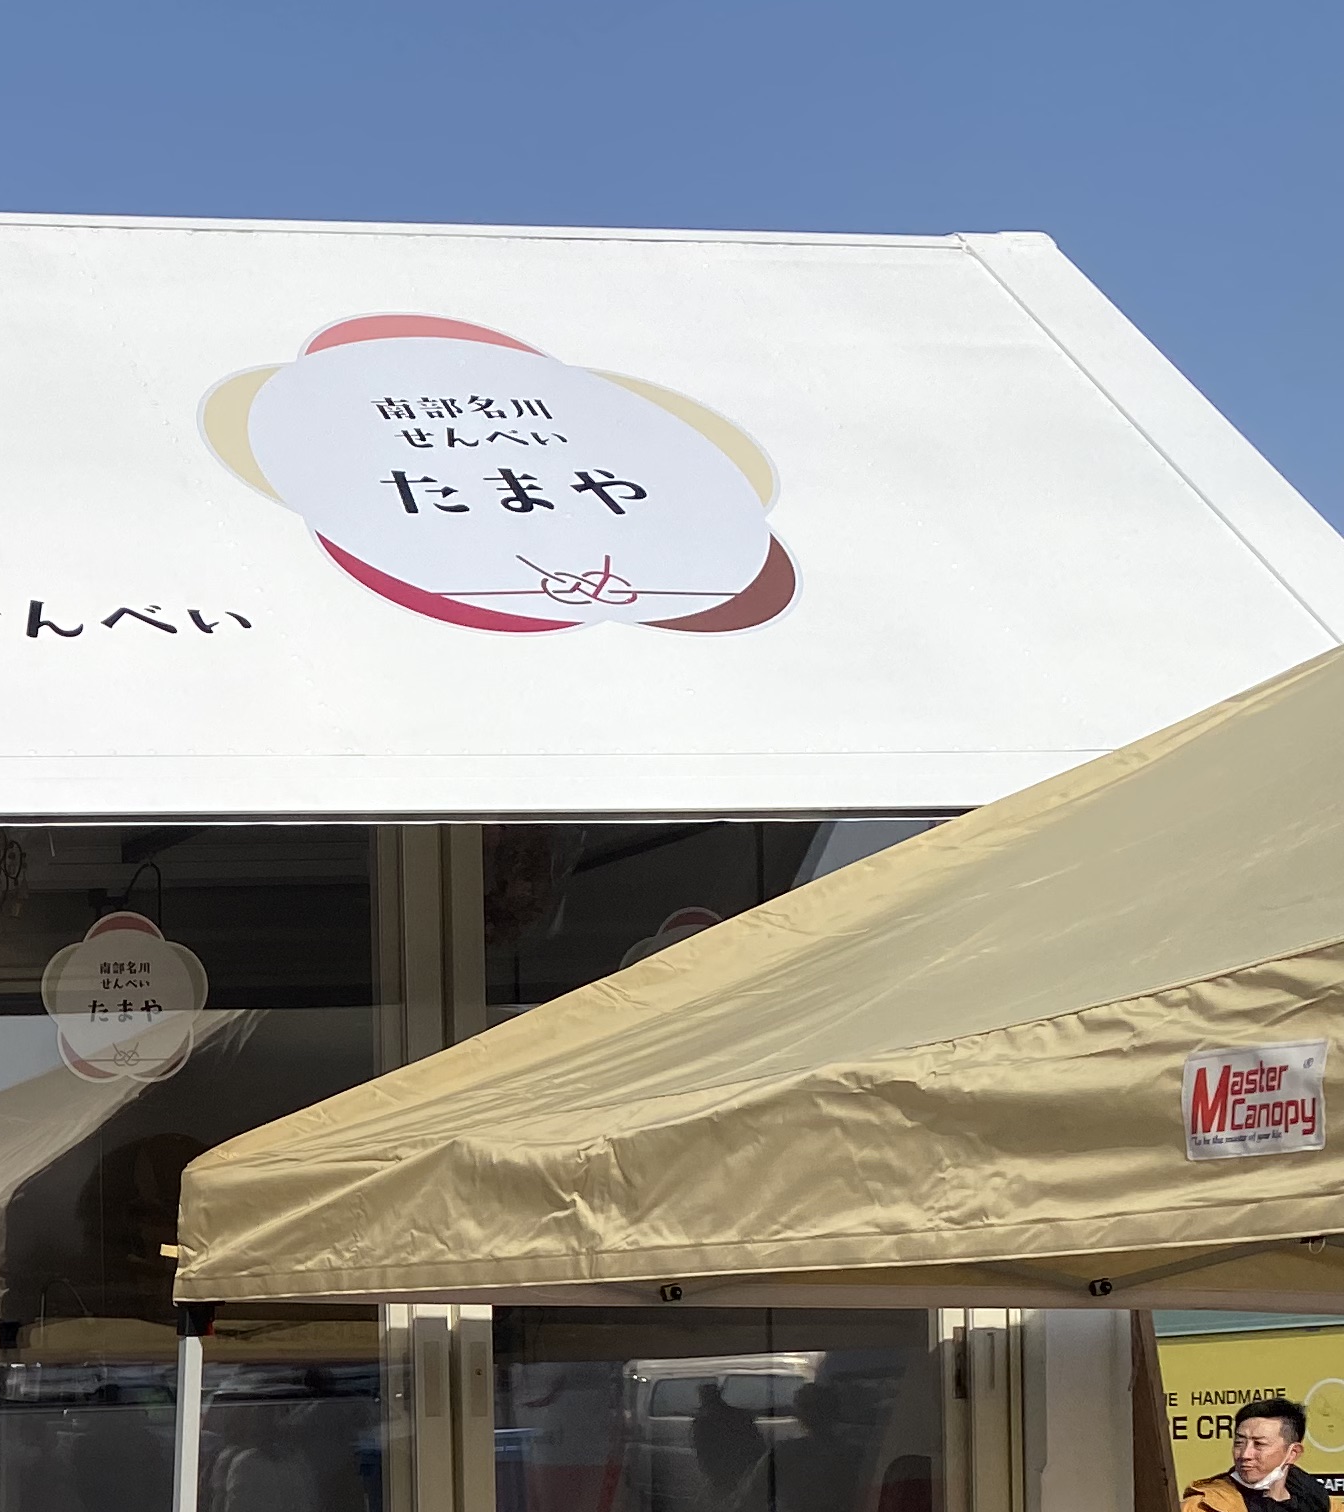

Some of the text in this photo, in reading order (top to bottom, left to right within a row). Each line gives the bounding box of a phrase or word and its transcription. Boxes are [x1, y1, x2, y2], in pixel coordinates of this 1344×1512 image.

[371, 394, 553, 421] 南部名川
[394, 426, 568, 449] せんべい
[379, 467, 648, 515] たまや
[99, 961, 151, 975] 南部名川
[100, 978, 151, 990] せんべい
[88, 999, 162, 1023] たまや
[1191, 1060, 1289, 1135] Master
[1230, 1097, 1317, 1136] Canopy
[1191, 1387, 1286, 1406] HANDMADE
